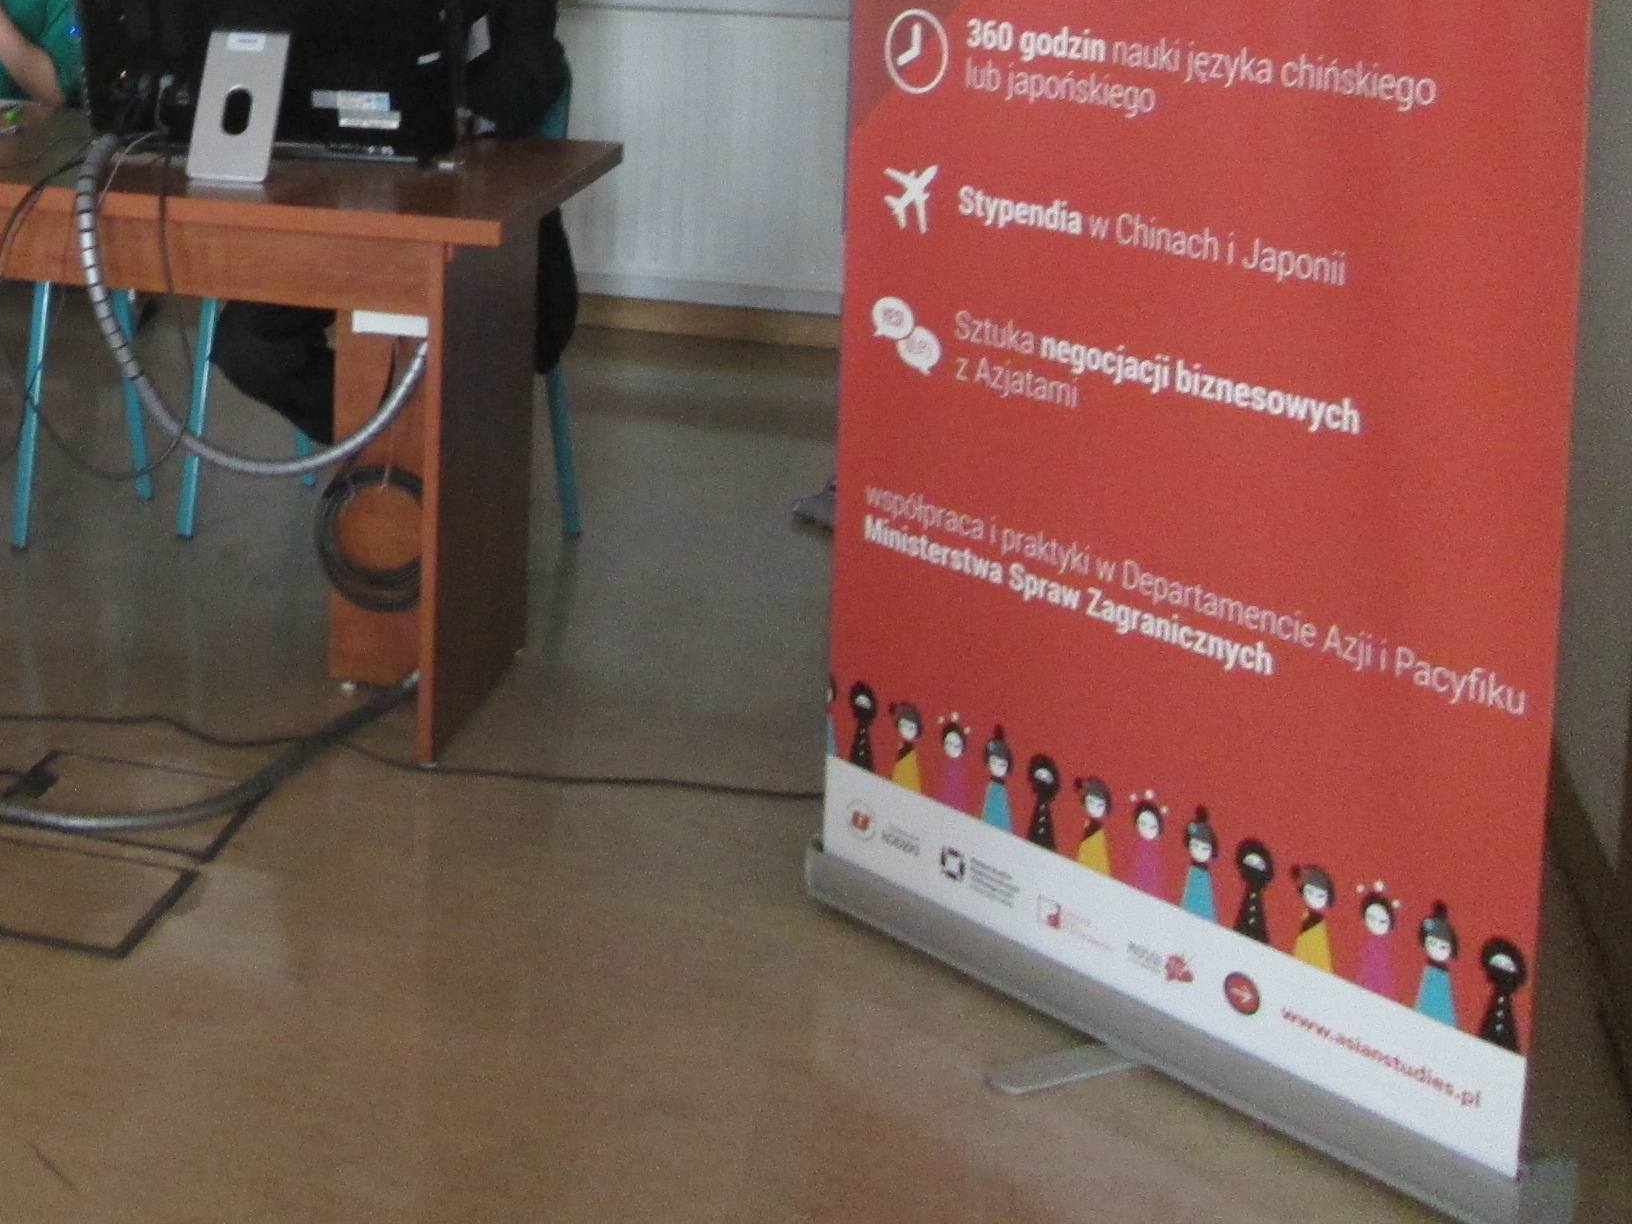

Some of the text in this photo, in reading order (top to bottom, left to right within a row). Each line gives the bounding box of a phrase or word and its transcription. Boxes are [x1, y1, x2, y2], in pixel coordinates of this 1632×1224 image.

[965, 58, 1156, 118] lub japońskiego
[967, 19, 1437, 112] 360 godzin nauki języka chińskiego
[958, 185, 1347, 287] Stypendia w Chinach i Japonii
[954, 310, 1361, 436] Sztuka negocjacji biznesowych
[954, 355, 1079, 409] z Azjatami
[864, 517, 1274, 676] Ministerstwa Spraw Zagranicznych
[865, 482, 1526, 716] współpraca i praktyki w Departamencie Azji i Pacyfiku
[1281, 1007, 1482, 1107] www.asianstudies.pl
